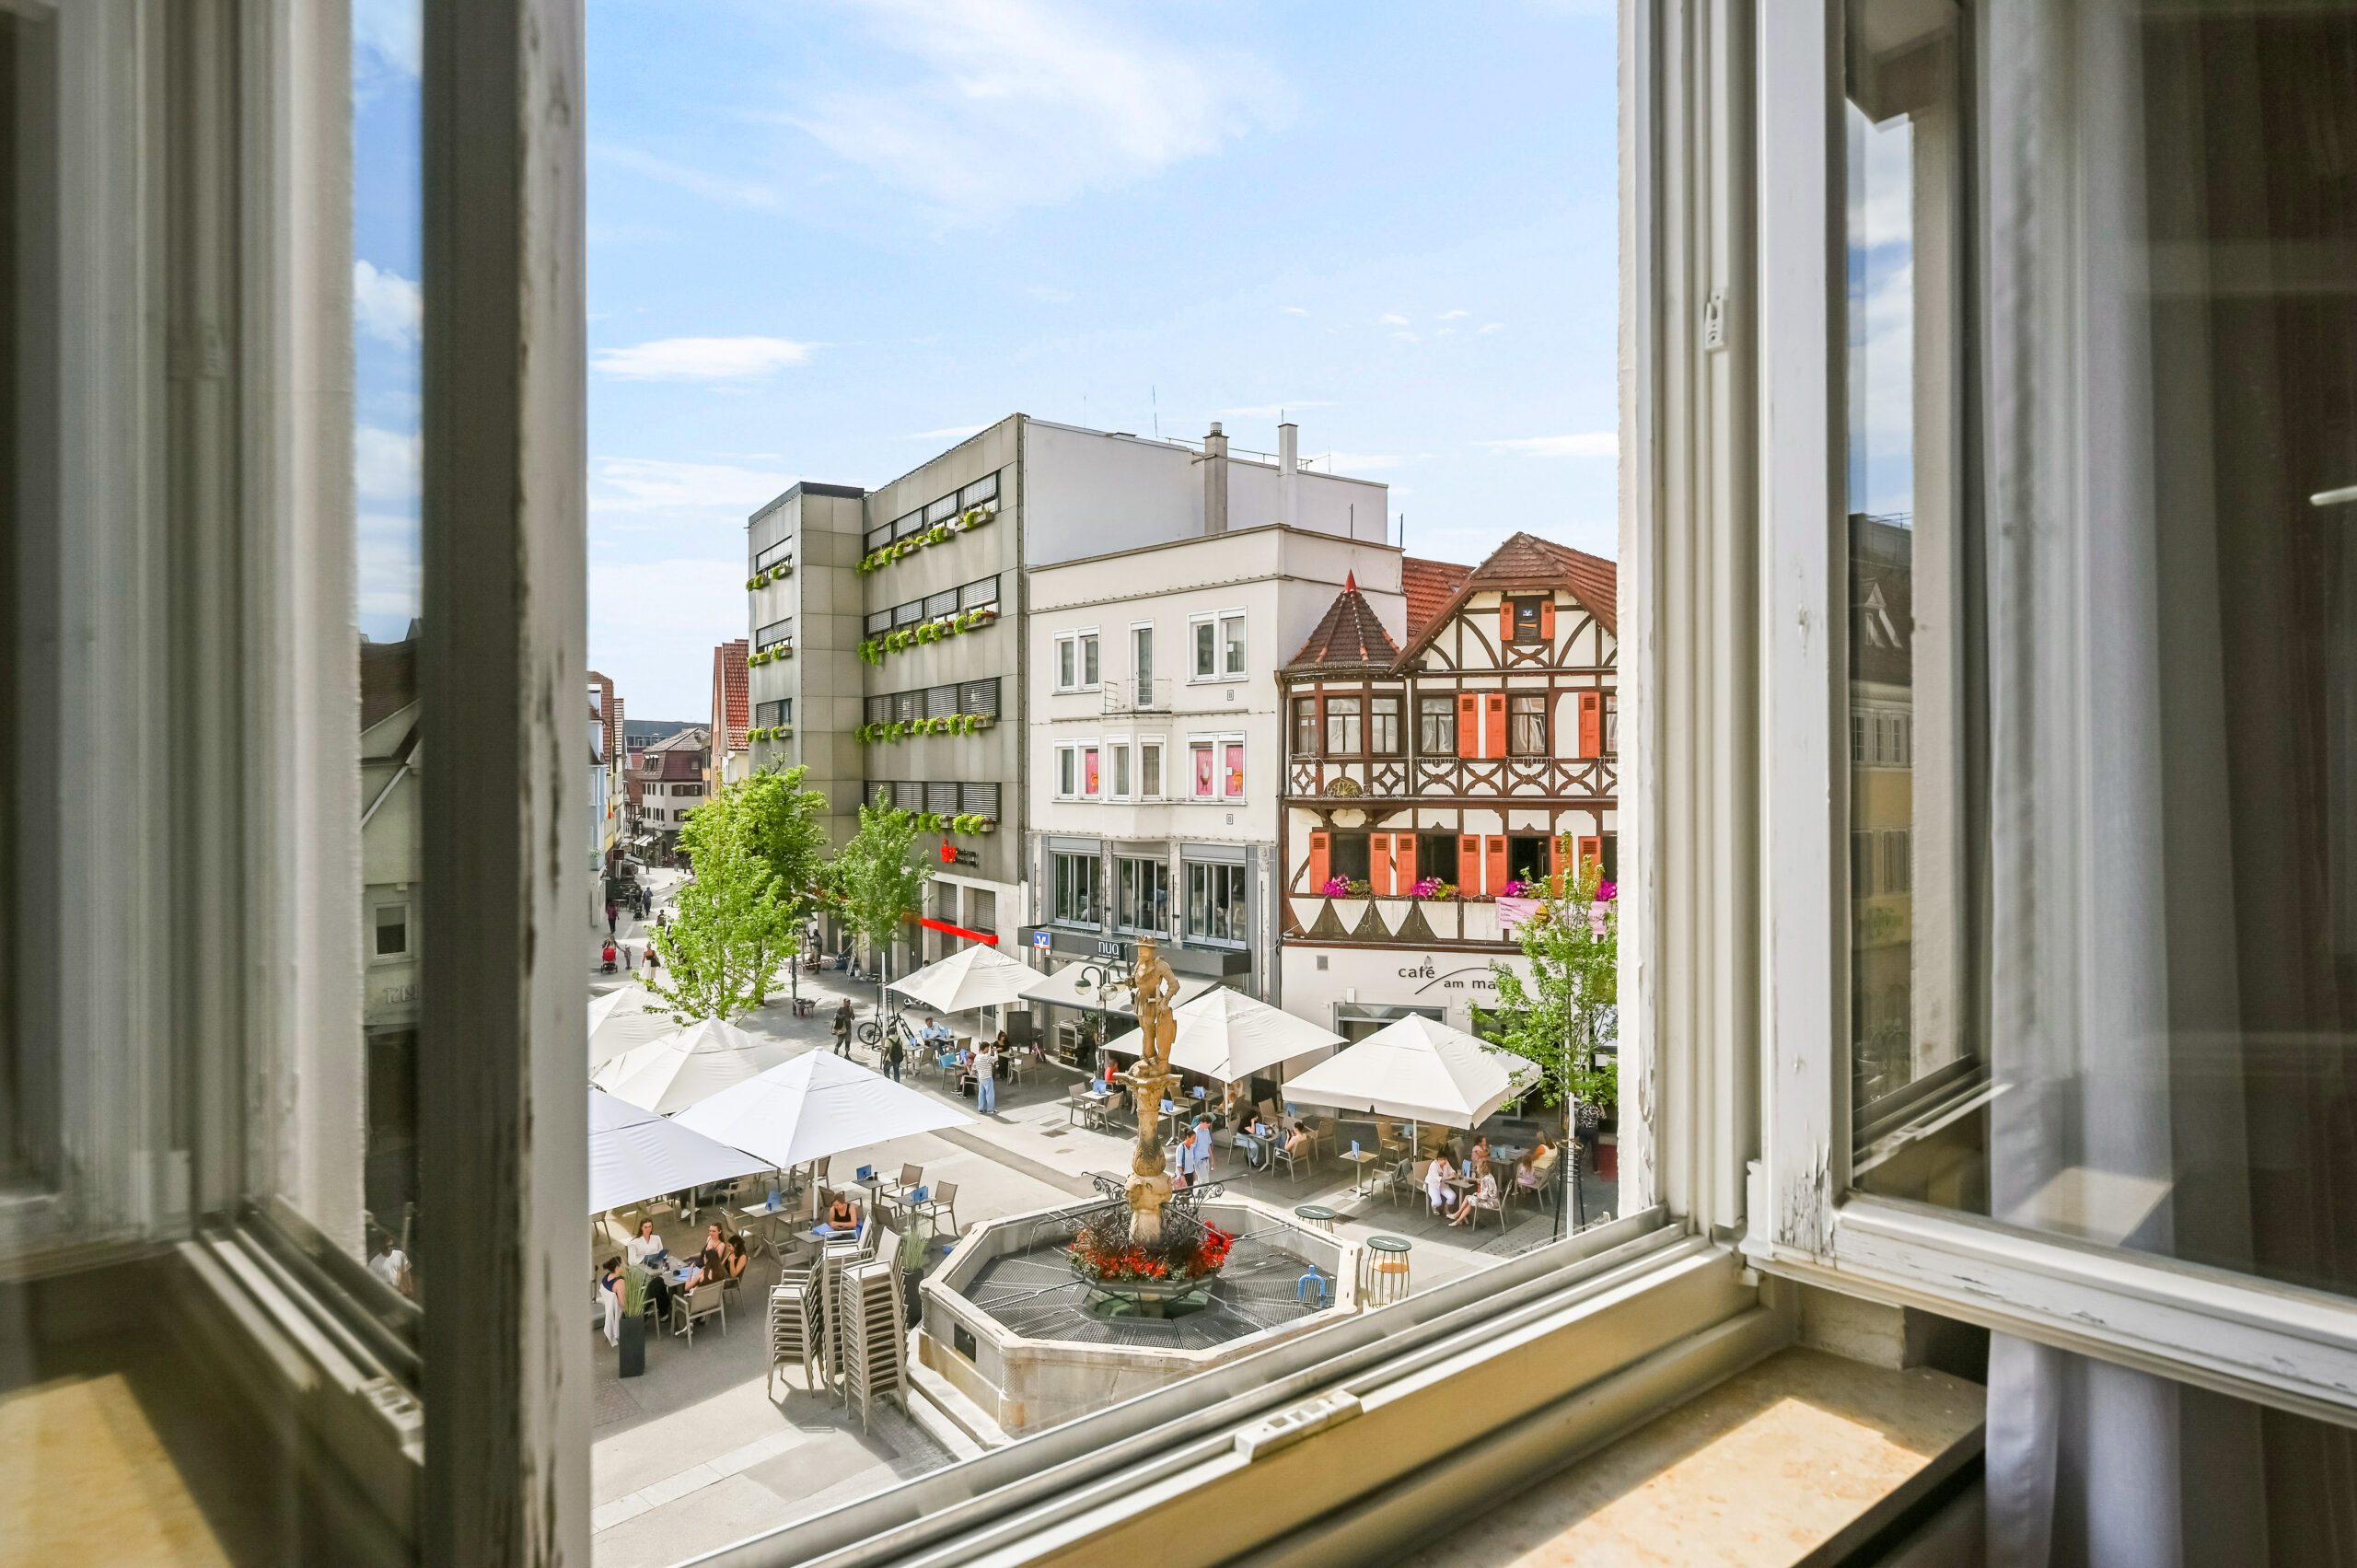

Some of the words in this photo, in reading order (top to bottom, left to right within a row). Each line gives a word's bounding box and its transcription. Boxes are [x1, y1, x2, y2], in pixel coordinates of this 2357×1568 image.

[1398, 966, 1435, 979] café
[1444, 981, 1464, 989] am
[1471, 980, 1496, 990] ma
